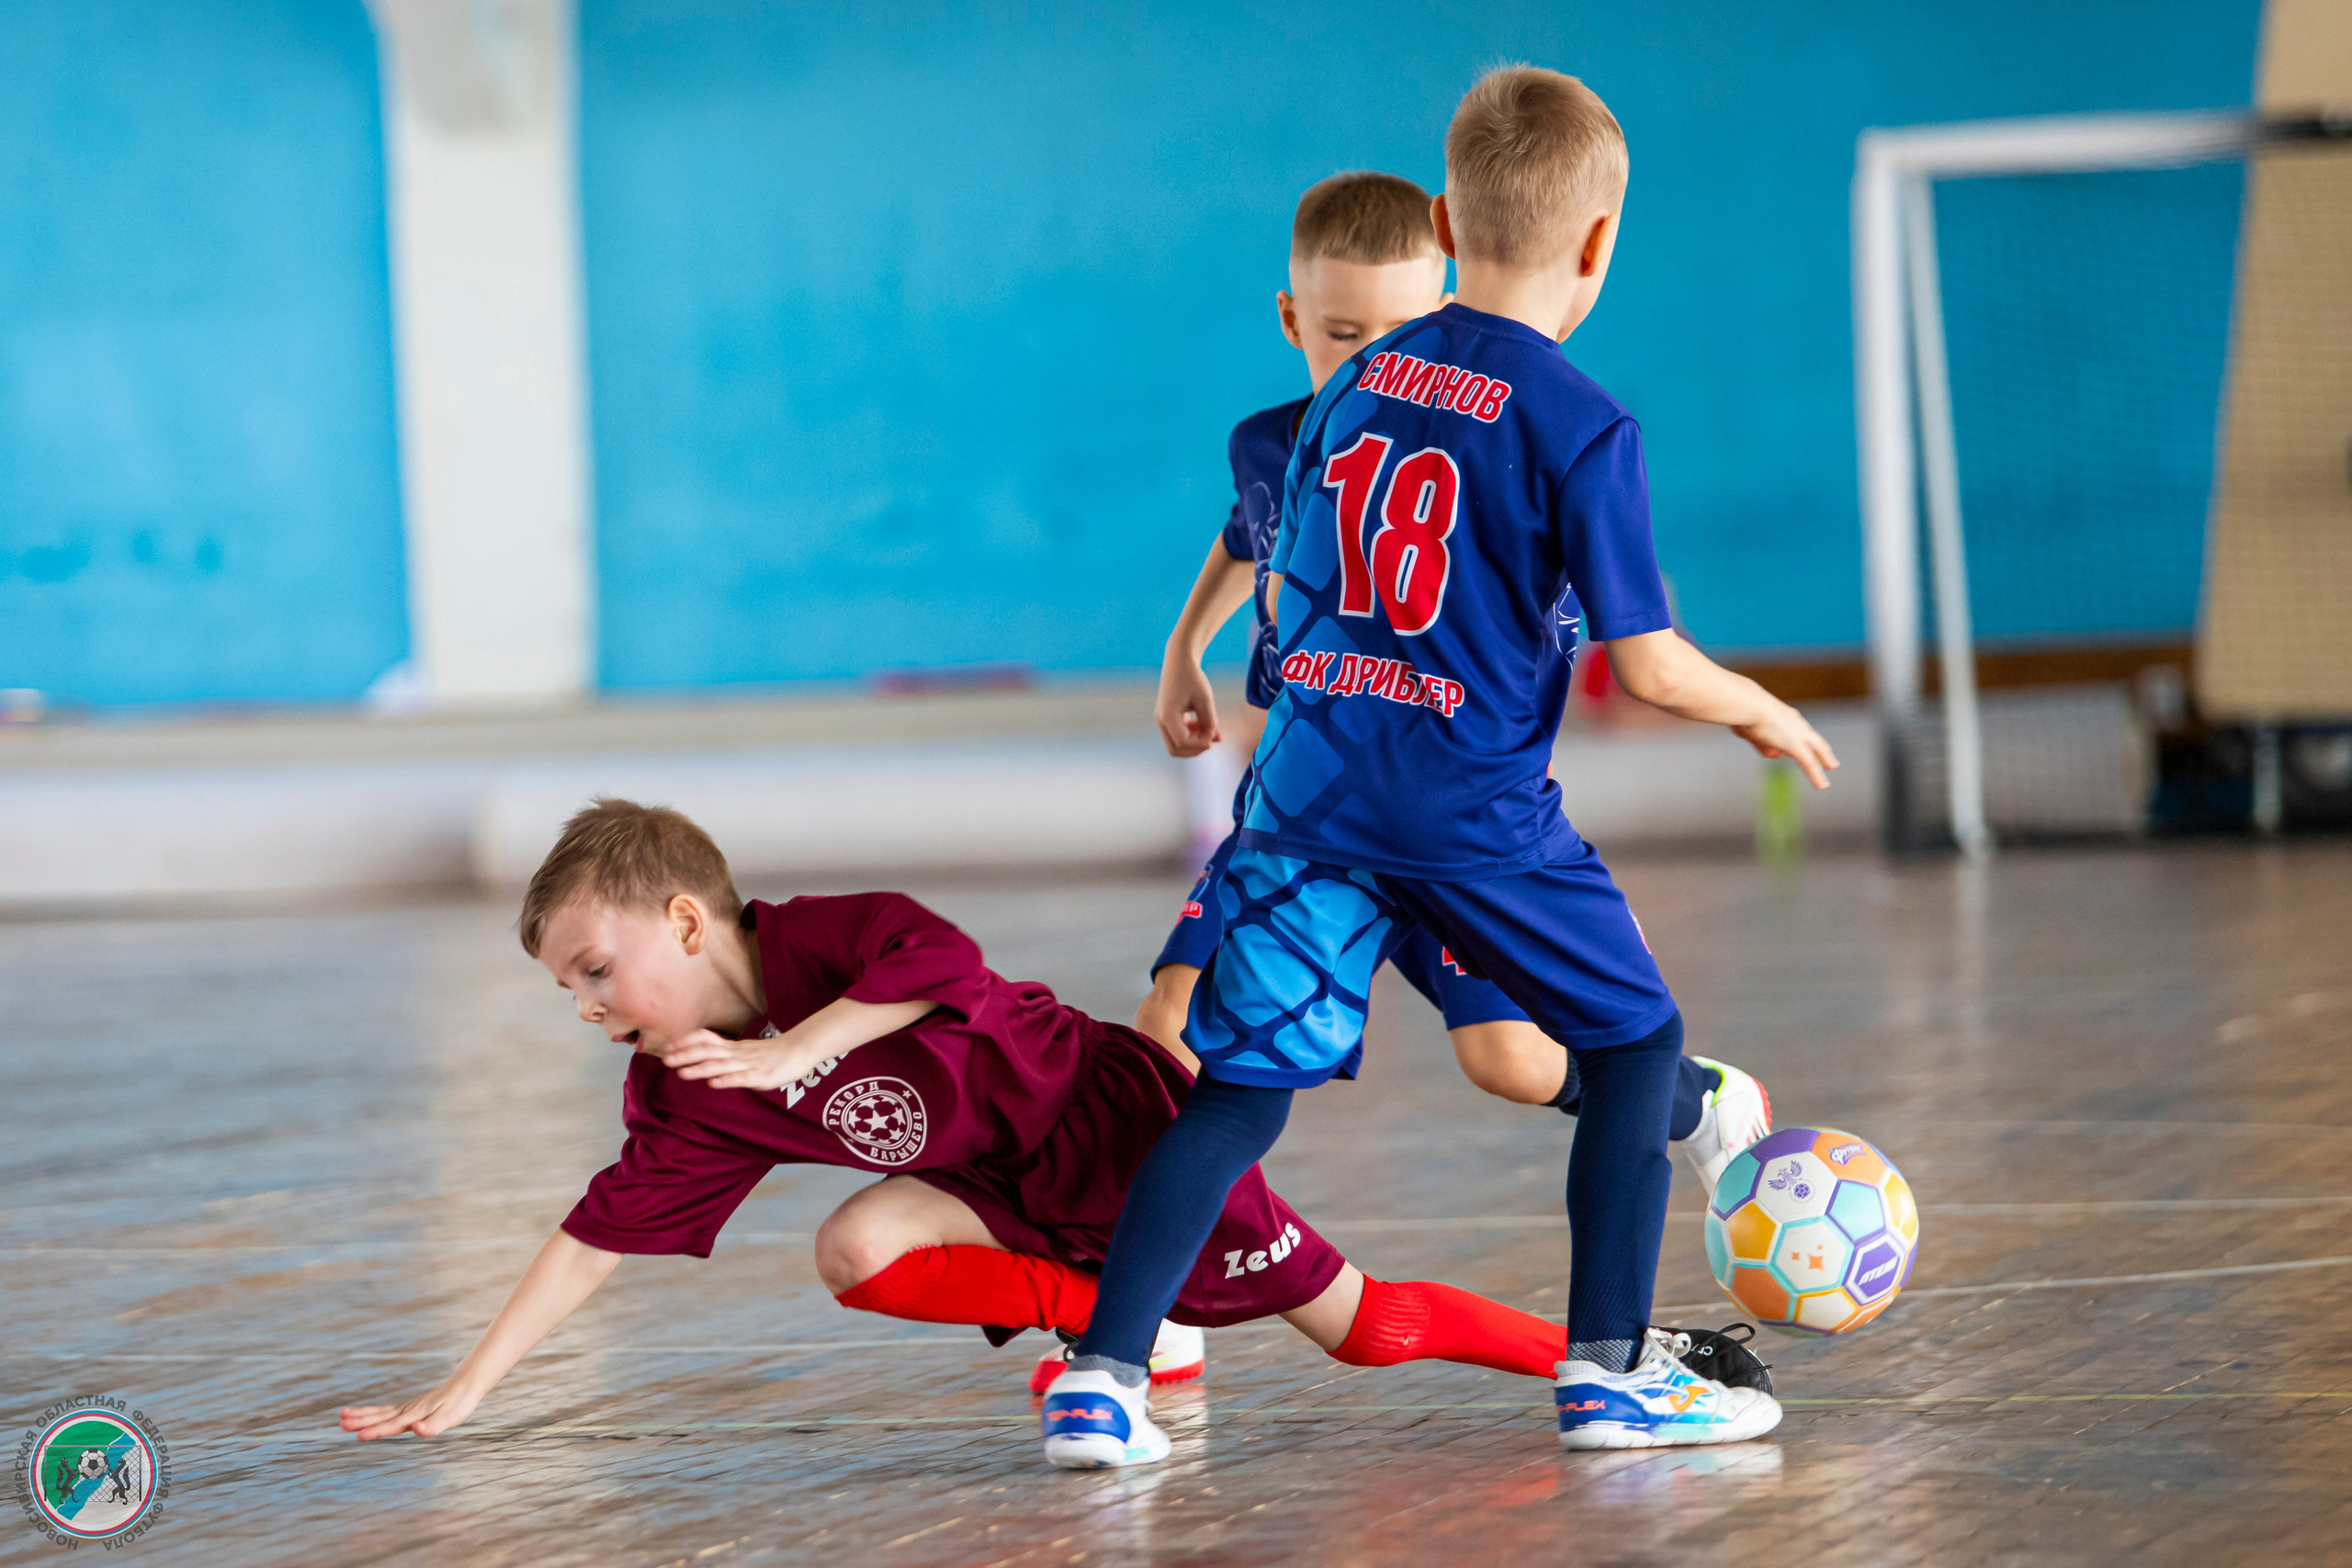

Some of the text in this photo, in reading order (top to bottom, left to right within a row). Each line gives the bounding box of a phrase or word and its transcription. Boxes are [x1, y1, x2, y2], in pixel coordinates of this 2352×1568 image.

[1357, 352, 1512, 423] СМИРНОВ
[1323, 430, 1459, 637] 18
[1282, 649, 1336, 691] ФК
[780, 1051, 850, 1110] Zeu
[829, 1081, 879, 1125] РЕКОРД
[870, 1111, 922, 1161] БАРЫШЕВО
[1224, 1222, 1301, 1280] Zeus
